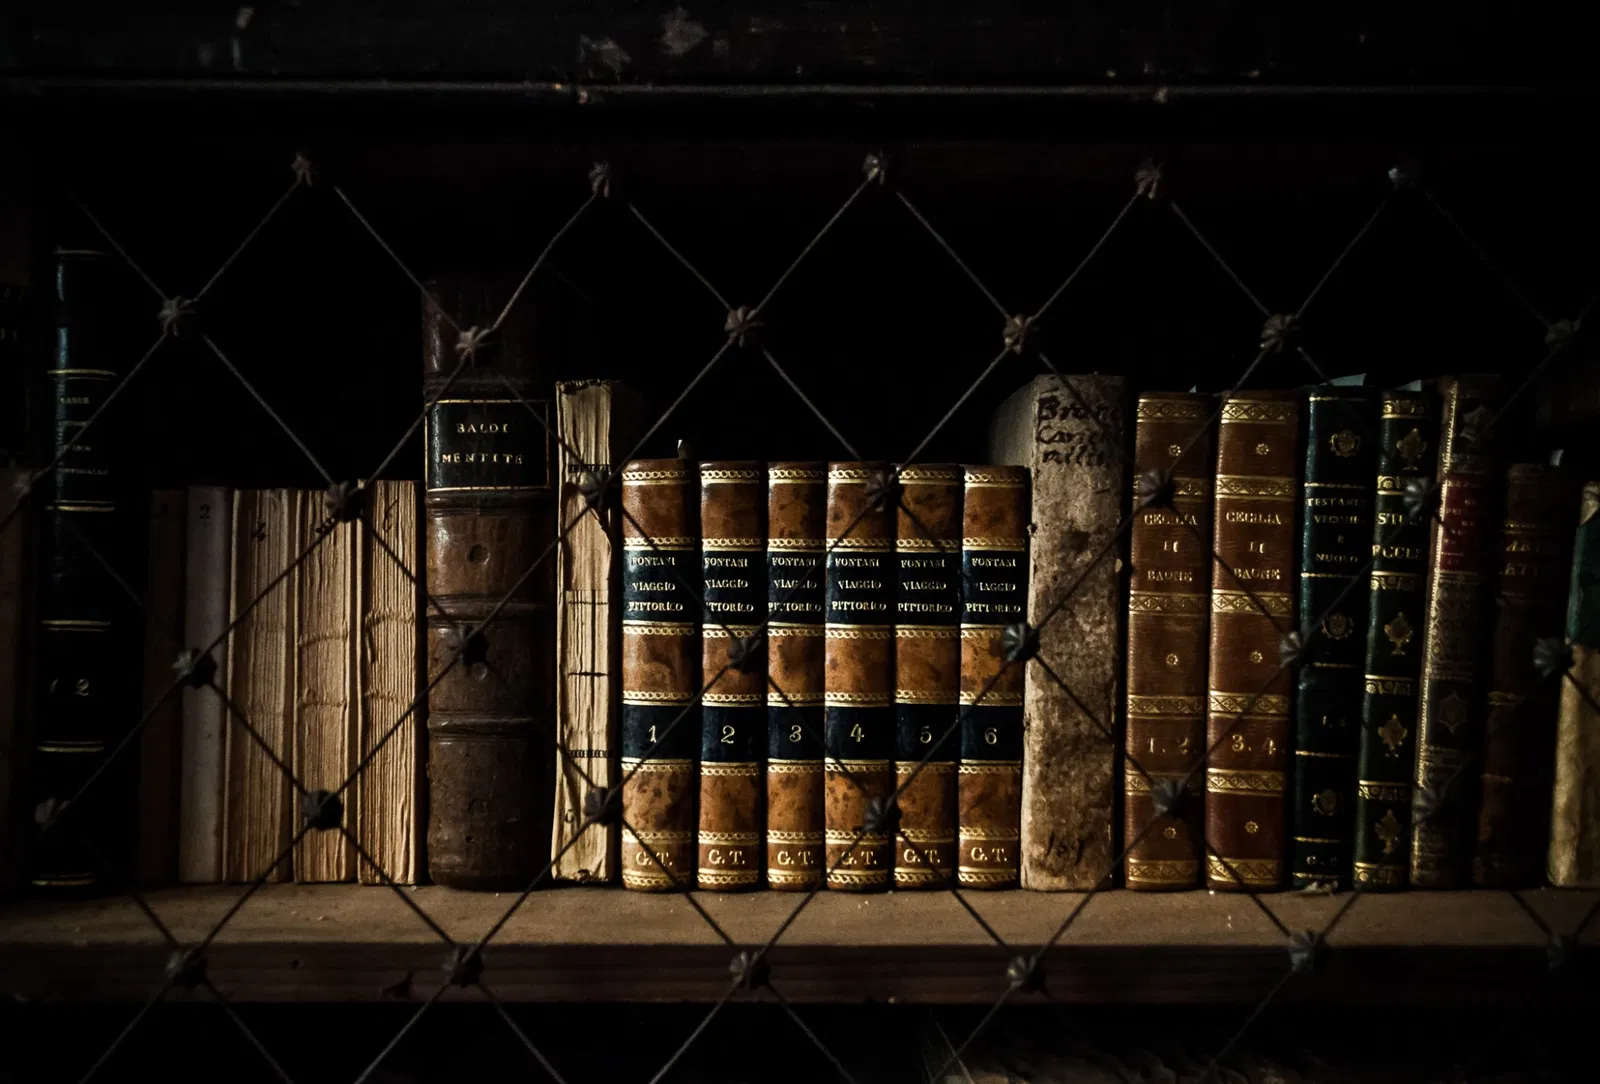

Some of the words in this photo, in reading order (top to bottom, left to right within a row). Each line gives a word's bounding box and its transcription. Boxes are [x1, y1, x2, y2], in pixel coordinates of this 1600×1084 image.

[704, 557, 749, 569] FONTANI
[771, 556, 816, 568] FONTANI
[834, 556, 880, 568] FONTANI
[900, 558, 946, 569] FONTANI
[971, 557, 1017, 568] FONTANI
[632, 582, 676, 593] VIAGGIO
[704, 579, 749, 590] VIAGGIO
[837, 580, 882, 590] VIAGGIO
[902, 580, 947, 591] VIAGGIO
[628, 602, 684, 613] PITTORICO
[831, 601, 888, 612] PITTORICO
[897, 603, 953, 613] PITTORICO
[648, 724, 658, 744] 1
[720, 724, 736, 744] 2
[788, 724, 803, 743] 3
[850, 723, 866, 743] 4
[919, 725, 933, 744] 5
[983, 726, 999, 746] 6
